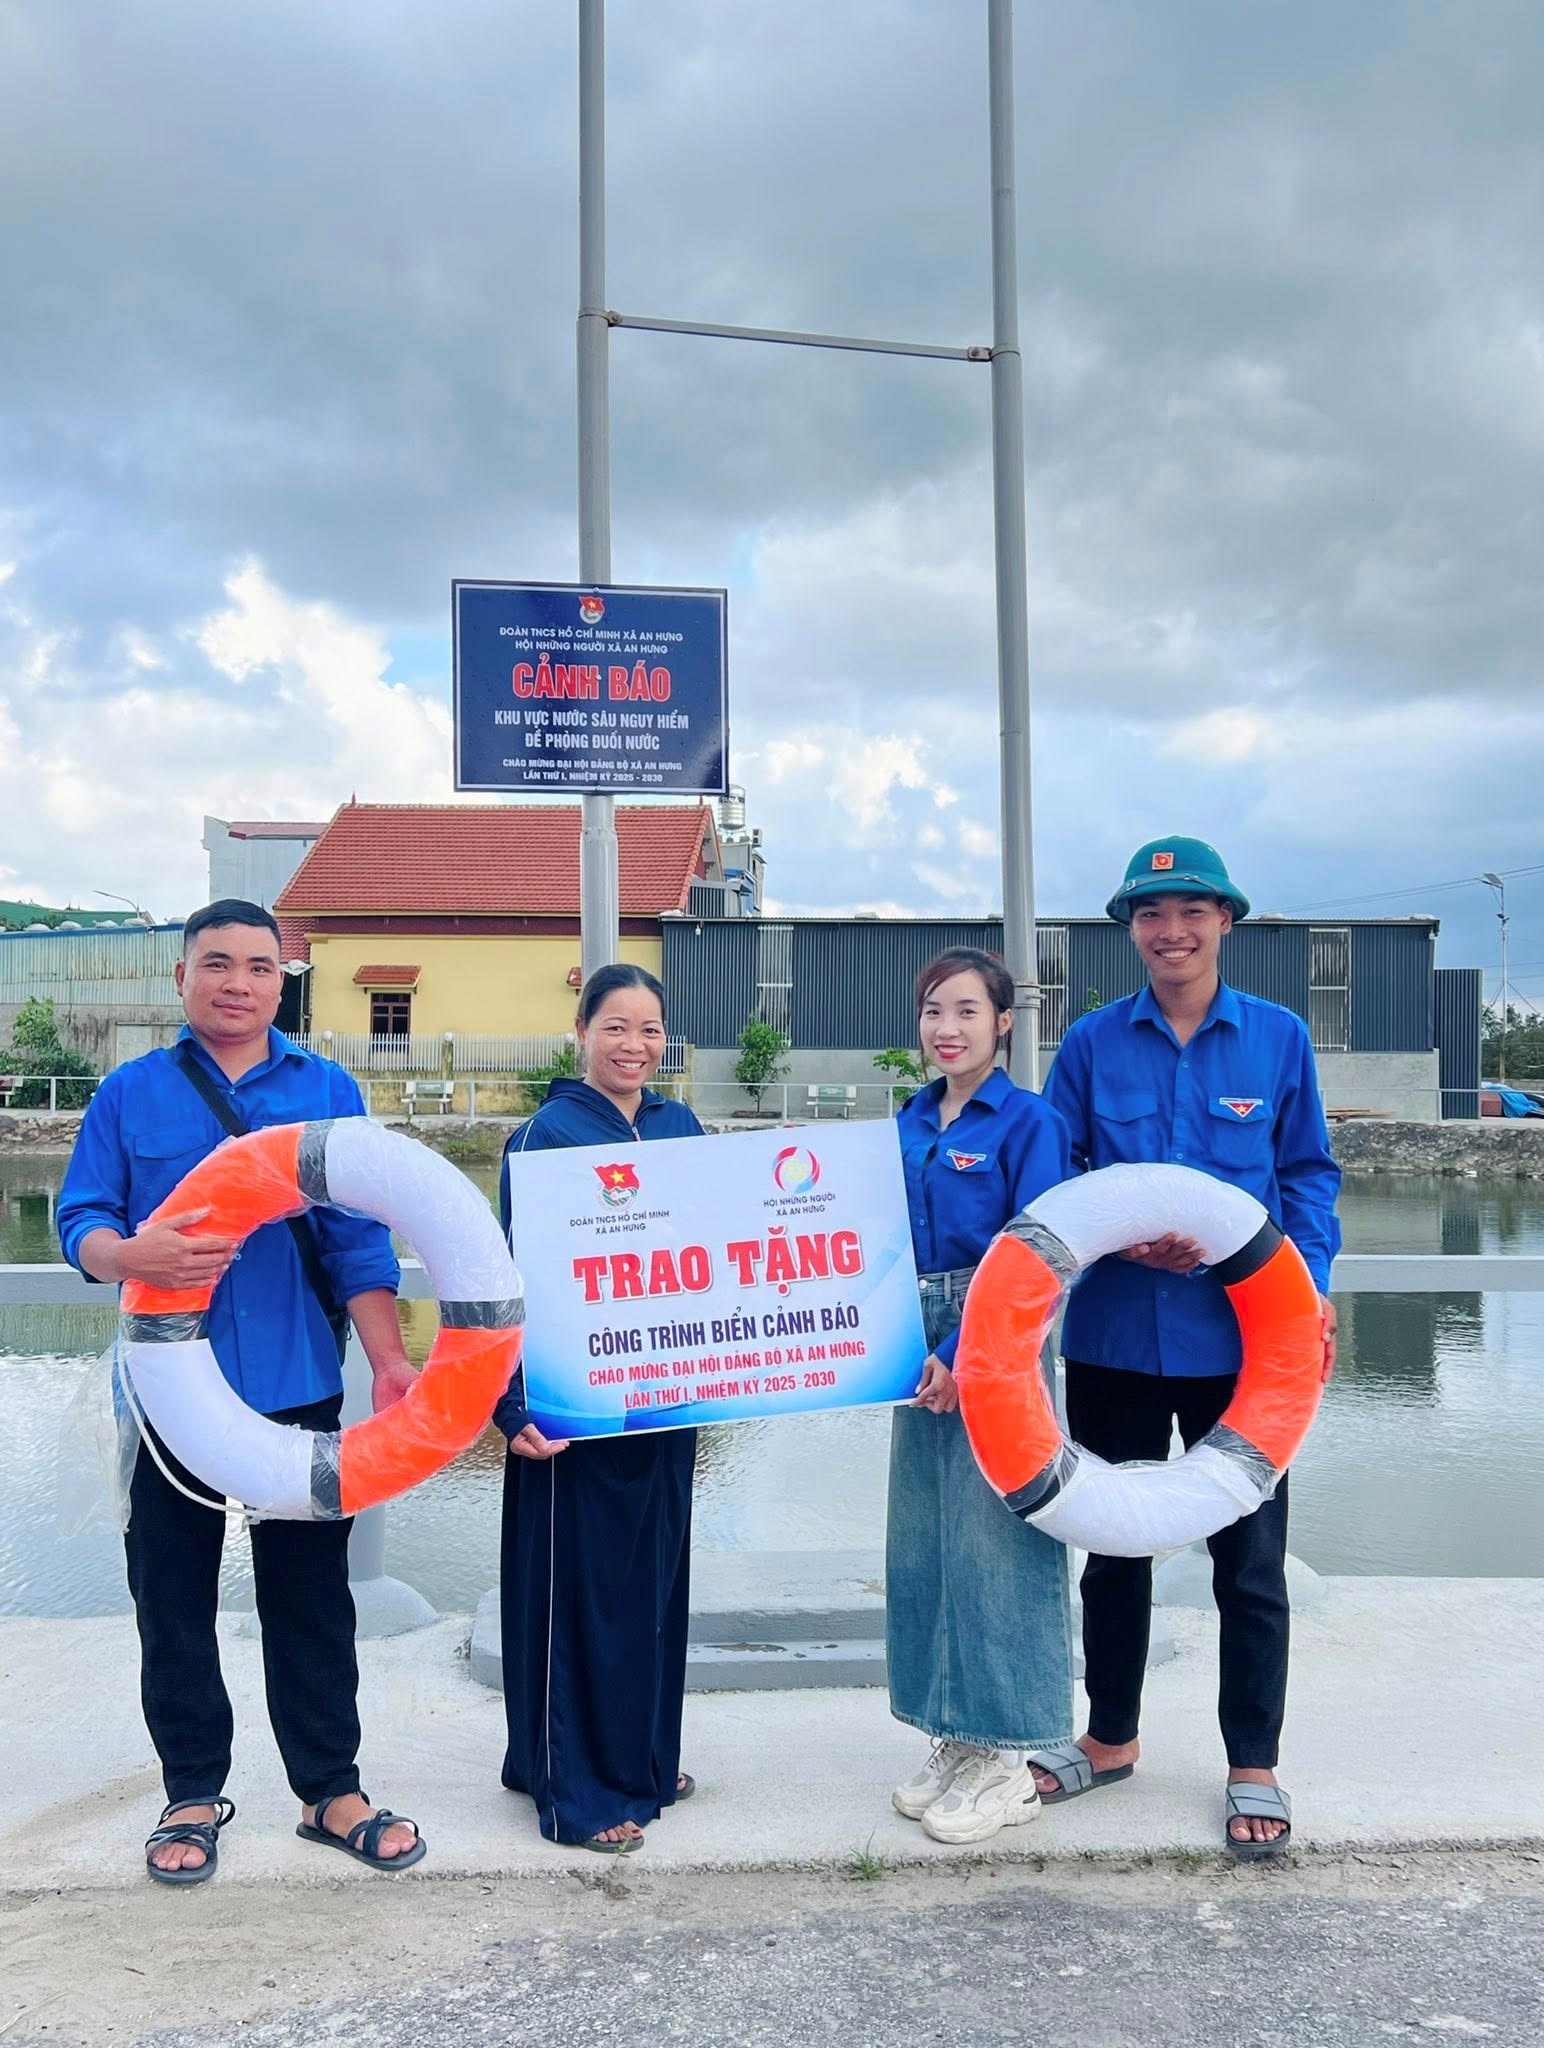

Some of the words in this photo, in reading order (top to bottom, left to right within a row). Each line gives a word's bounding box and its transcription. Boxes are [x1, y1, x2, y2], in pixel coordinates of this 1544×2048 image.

[499, 625, 529, 636] ĐOÀN
[531, 628, 556, 637] TNCS
[575, 627, 593, 638] CHÍ
[595, 630, 621, 639] MINH
[639, 632, 653, 641] AN
[655, 632, 684, 642] HƯNG
[515, 638, 533, 651] HỘI
[535, 640, 571, 650] NHỮNG
[573, 641, 606, 652] NGƯỜI
[624, 644, 638, 653] AN
[640, 644, 668, 654] HƯNG
[512, 651, 600, 700] CẢNH
[608, 659, 671, 702] BÁO
[494, 710, 520, 725] KHU
[524, 710, 549, 729] VỰC
[552, 709, 588, 727] NƯỚC
[591, 710, 617, 728] SÂU
[620, 714, 654, 729] NGUY
[657, 709, 689, 729] HIỂM
[524, 729, 542, 748] ĐỀ
[545, 731, 589, 749] PHÒNG
[592, 730, 622, 749] ĐUỐI
[625, 732, 660, 750] NƯỚC
[502, 757, 527, 768] CHÀO
[528, 758, 555, 768] MỪNG
[556, 759, 572, 770] ĐẠI
[574, 758, 589, 770] HỘI
[590, 758, 615, 769] ĐẢNG
[616, 760, 629, 771] BỘ
[644, 761, 657, 770] AN
[658, 762, 682, 771] HƯNG
[542, 771, 561, 780] THỨ
[569, 771, 598, 782] NHIỆM
[613, 773, 634, 782] 2025
[641, 774, 663, 782] 2030
[570, 1216, 594, 1227] ĐOÀN
[595, 1215, 616, 1225] TNCS
[632, 1210, 647, 1221] CHÍ
[649, 1210, 670, 1219] MINH
[789, 1207, 801, 1216] AN
[802, 1204, 826, 1214] HƯNG
[609, 1225, 621, 1233] AN
[622, 1222, 646, 1232] HƯNG
[572, 1244, 713, 1304] TRAO
[726, 1225, 865, 1297] TẶNG
[588, 1326, 642, 1357] CÔNG
[647, 1318, 706, 1351] TRÌNH
[712, 1306, 757, 1345] BIỂN
[763, 1305, 816, 1338] CẢNH
[820, 1302, 860, 1331] BÁO
[589, 1366, 624, 1386] CHÀO
[628, 1362, 668, 1382] MỪNG
[672, 1359, 695, 1379] ĐẠI
[698, 1354, 721, 1376] HỘI
[724, 1350, 761, 1370] ĐẢNG
[765, 1347, 782, 1368] BỘ
[786, 1345, 804, 1364] XÃ
[808, 1345, 826, 1361] AN
[829, 1341, 866, 1359] HƯNG
[654, 1384, 681, 1405] THỨ
[684, 1387, 693, 1403] I,
[696, 1380, 740, 1401] NHIỆM
[743, 1376, 760, 1395] KỲ
